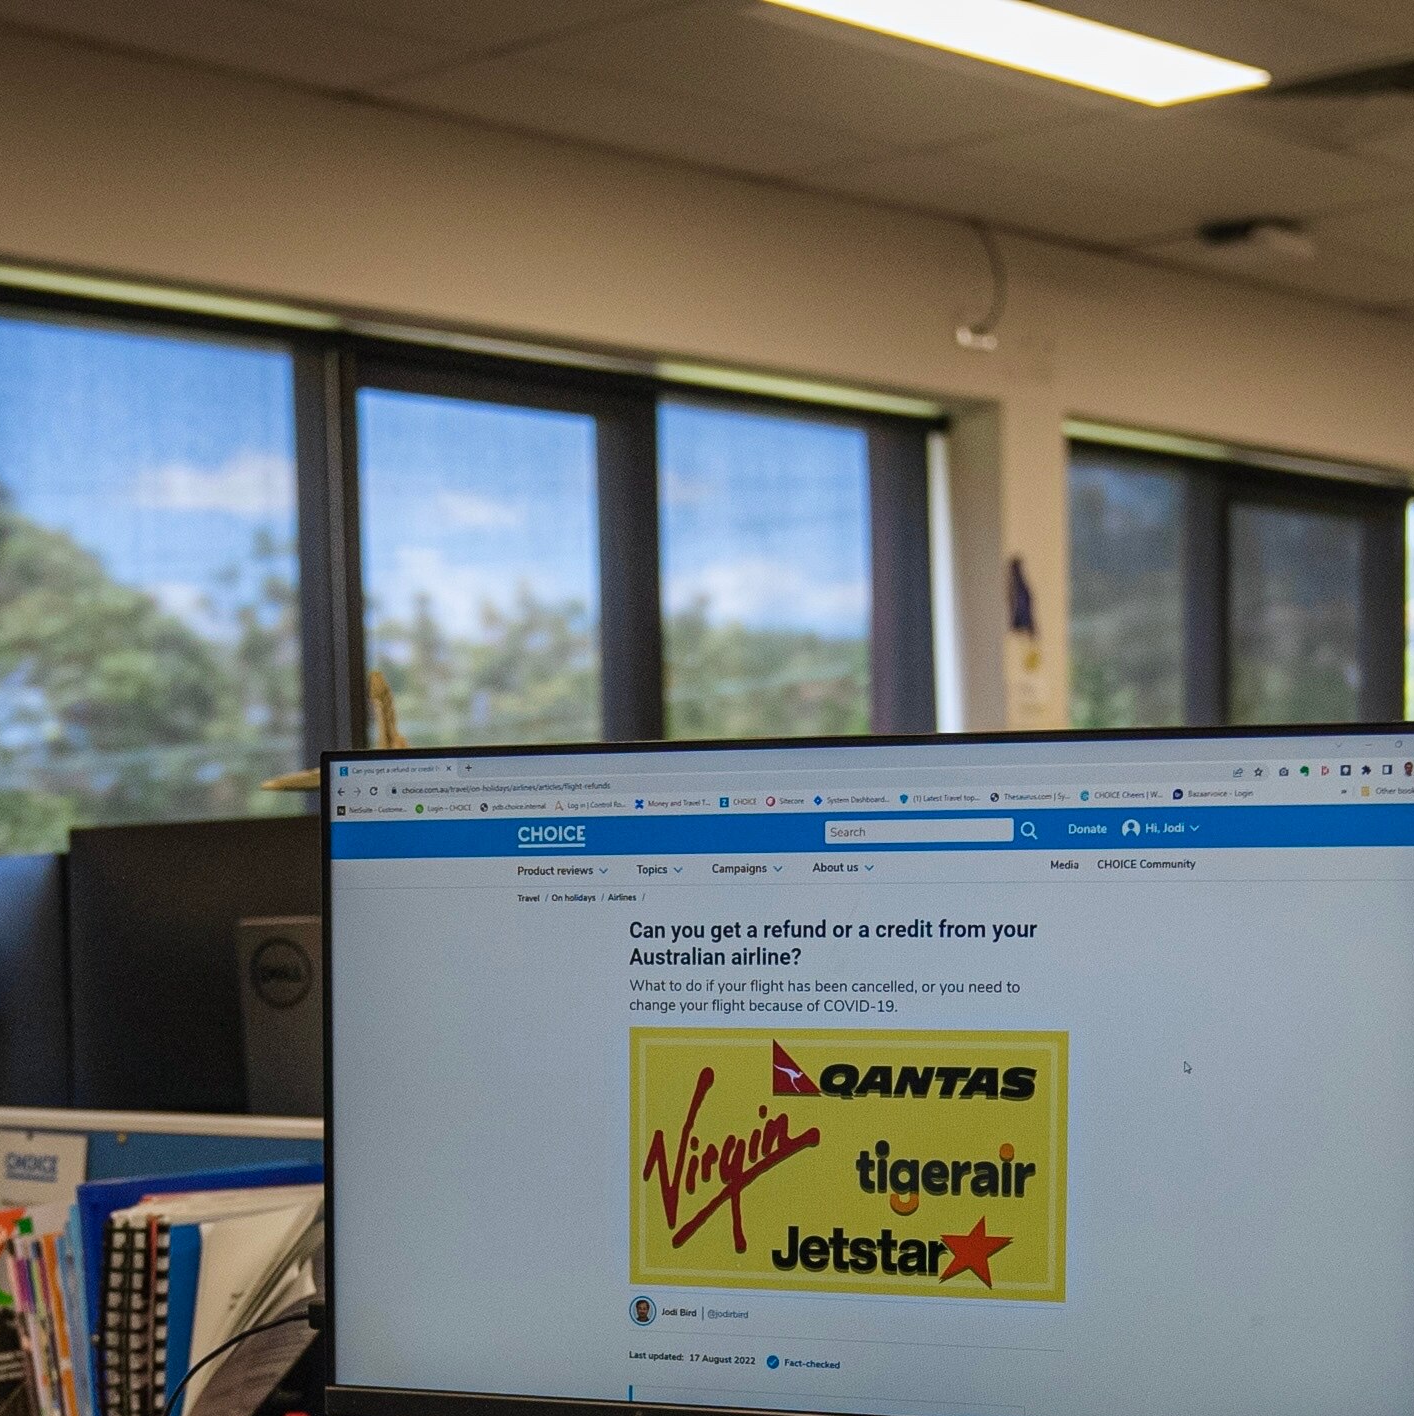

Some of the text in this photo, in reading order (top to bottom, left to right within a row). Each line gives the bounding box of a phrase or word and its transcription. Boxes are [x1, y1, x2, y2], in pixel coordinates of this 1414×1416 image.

[518, 826, 586, 843] CHOICE
[830, 827, 866, 838] Search
[1068, 824, 1107, 834] Donate
[1145, 822, 1185, 835] Hi, Jodi
[517, 865, 594, 876] Product reviews
[636, 864, 668, 877] Topics
[711, 863, 767, 876] Campaigns
[812, 862, 859, 873] About us
[1050, 860, 1079, 870] Media
[1097, 859, 1196, 871] CHOICE Community
[517, 894, 540, 902] Travel
[551, 893, 596, 903] On holidays
[608, 893, 637, 902] Airlines
[629, 919, 1037, 944] Can you get a refund or a credit from your
[629, 947, 802, 967] Australian airline?
[629, 978, 1021, 998] What to do if your flight has been cancelled, or you need to
[629, 998, 898, 1016] change your flight because of COVID-19.
[819, 1063, 1037, 1101] QANTAS
[643, 1067, 820, 1253] Virgin
[856, 1140, 1036, 1215] tigerair
[772, 1226, 948, 1277] Jetstar
[661, 1308, 697, 1318] Jodi Bird
[629, 1351, 756, 1366] Last updated: 17 August 2022
[784, 1359, 840, 1369] Fact-checked
